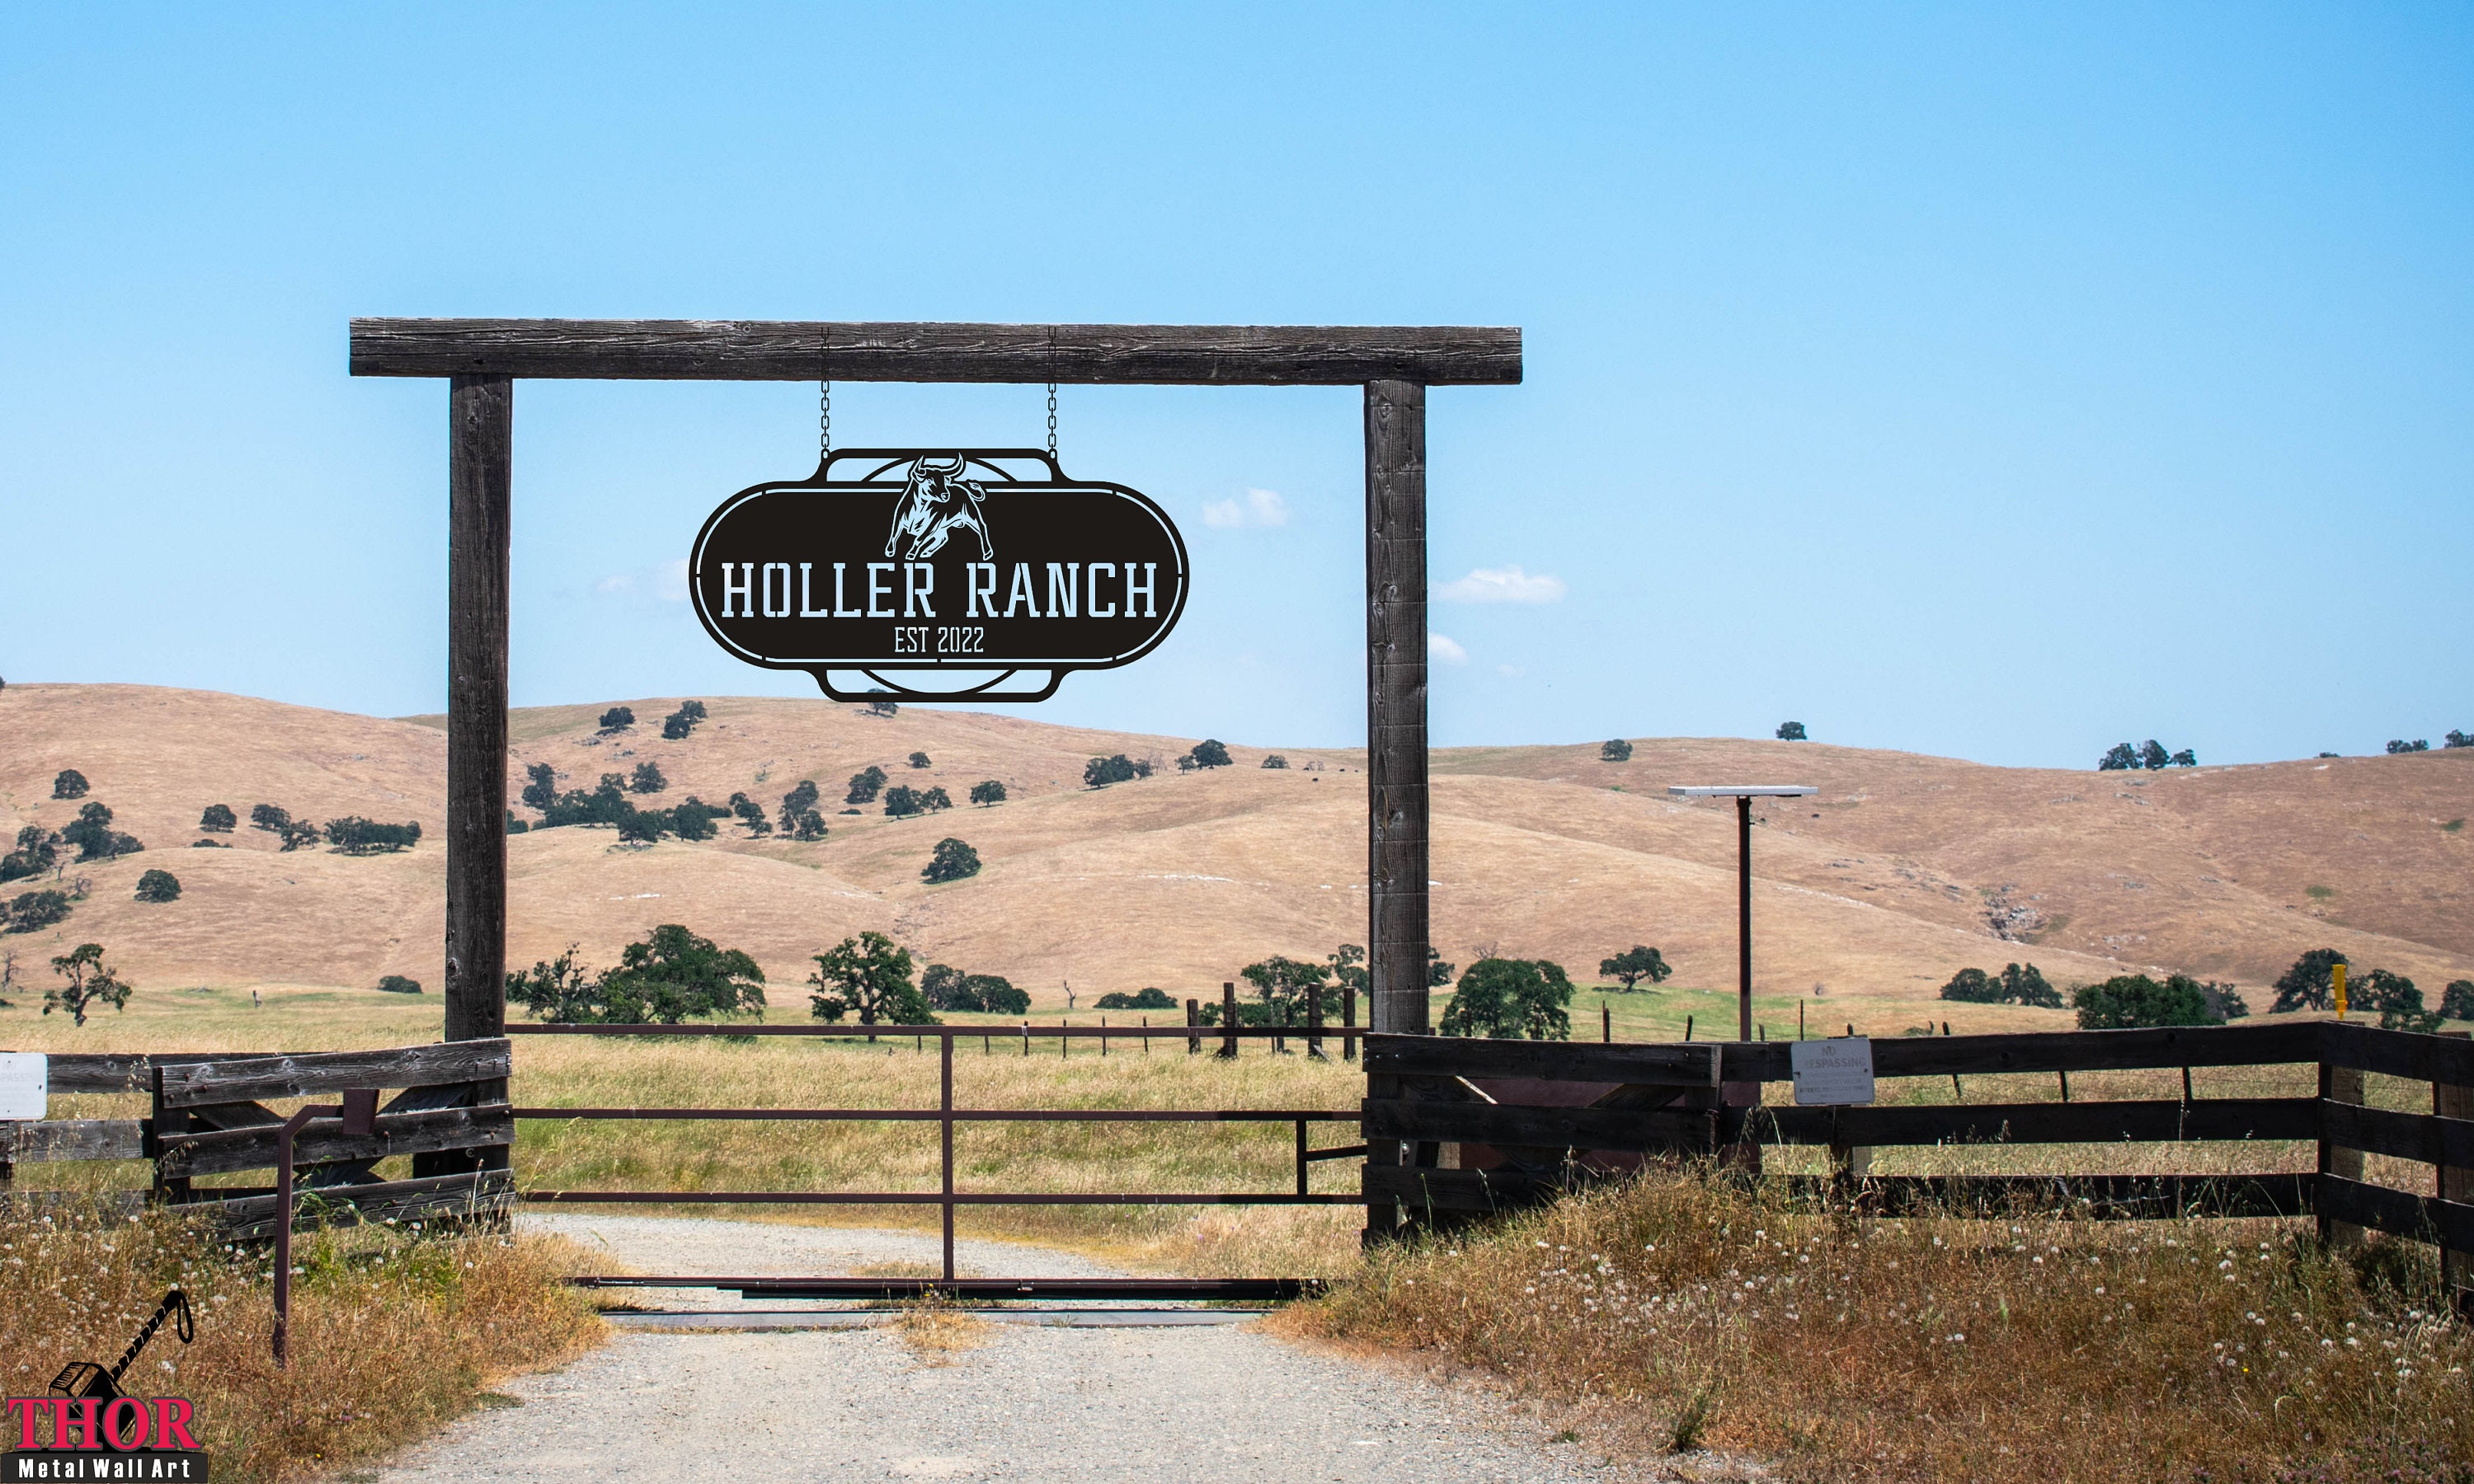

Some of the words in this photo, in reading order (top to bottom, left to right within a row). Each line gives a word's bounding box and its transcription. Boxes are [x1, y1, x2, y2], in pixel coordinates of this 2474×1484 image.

[721, 562, 937, 618] HOLLER
[966, 562, 1158, 618] RANCH
[894, 627, 929, 653] EST
[938, 627, 985, 653] 2022
[1821, 1045, 1837, 1057] NO
